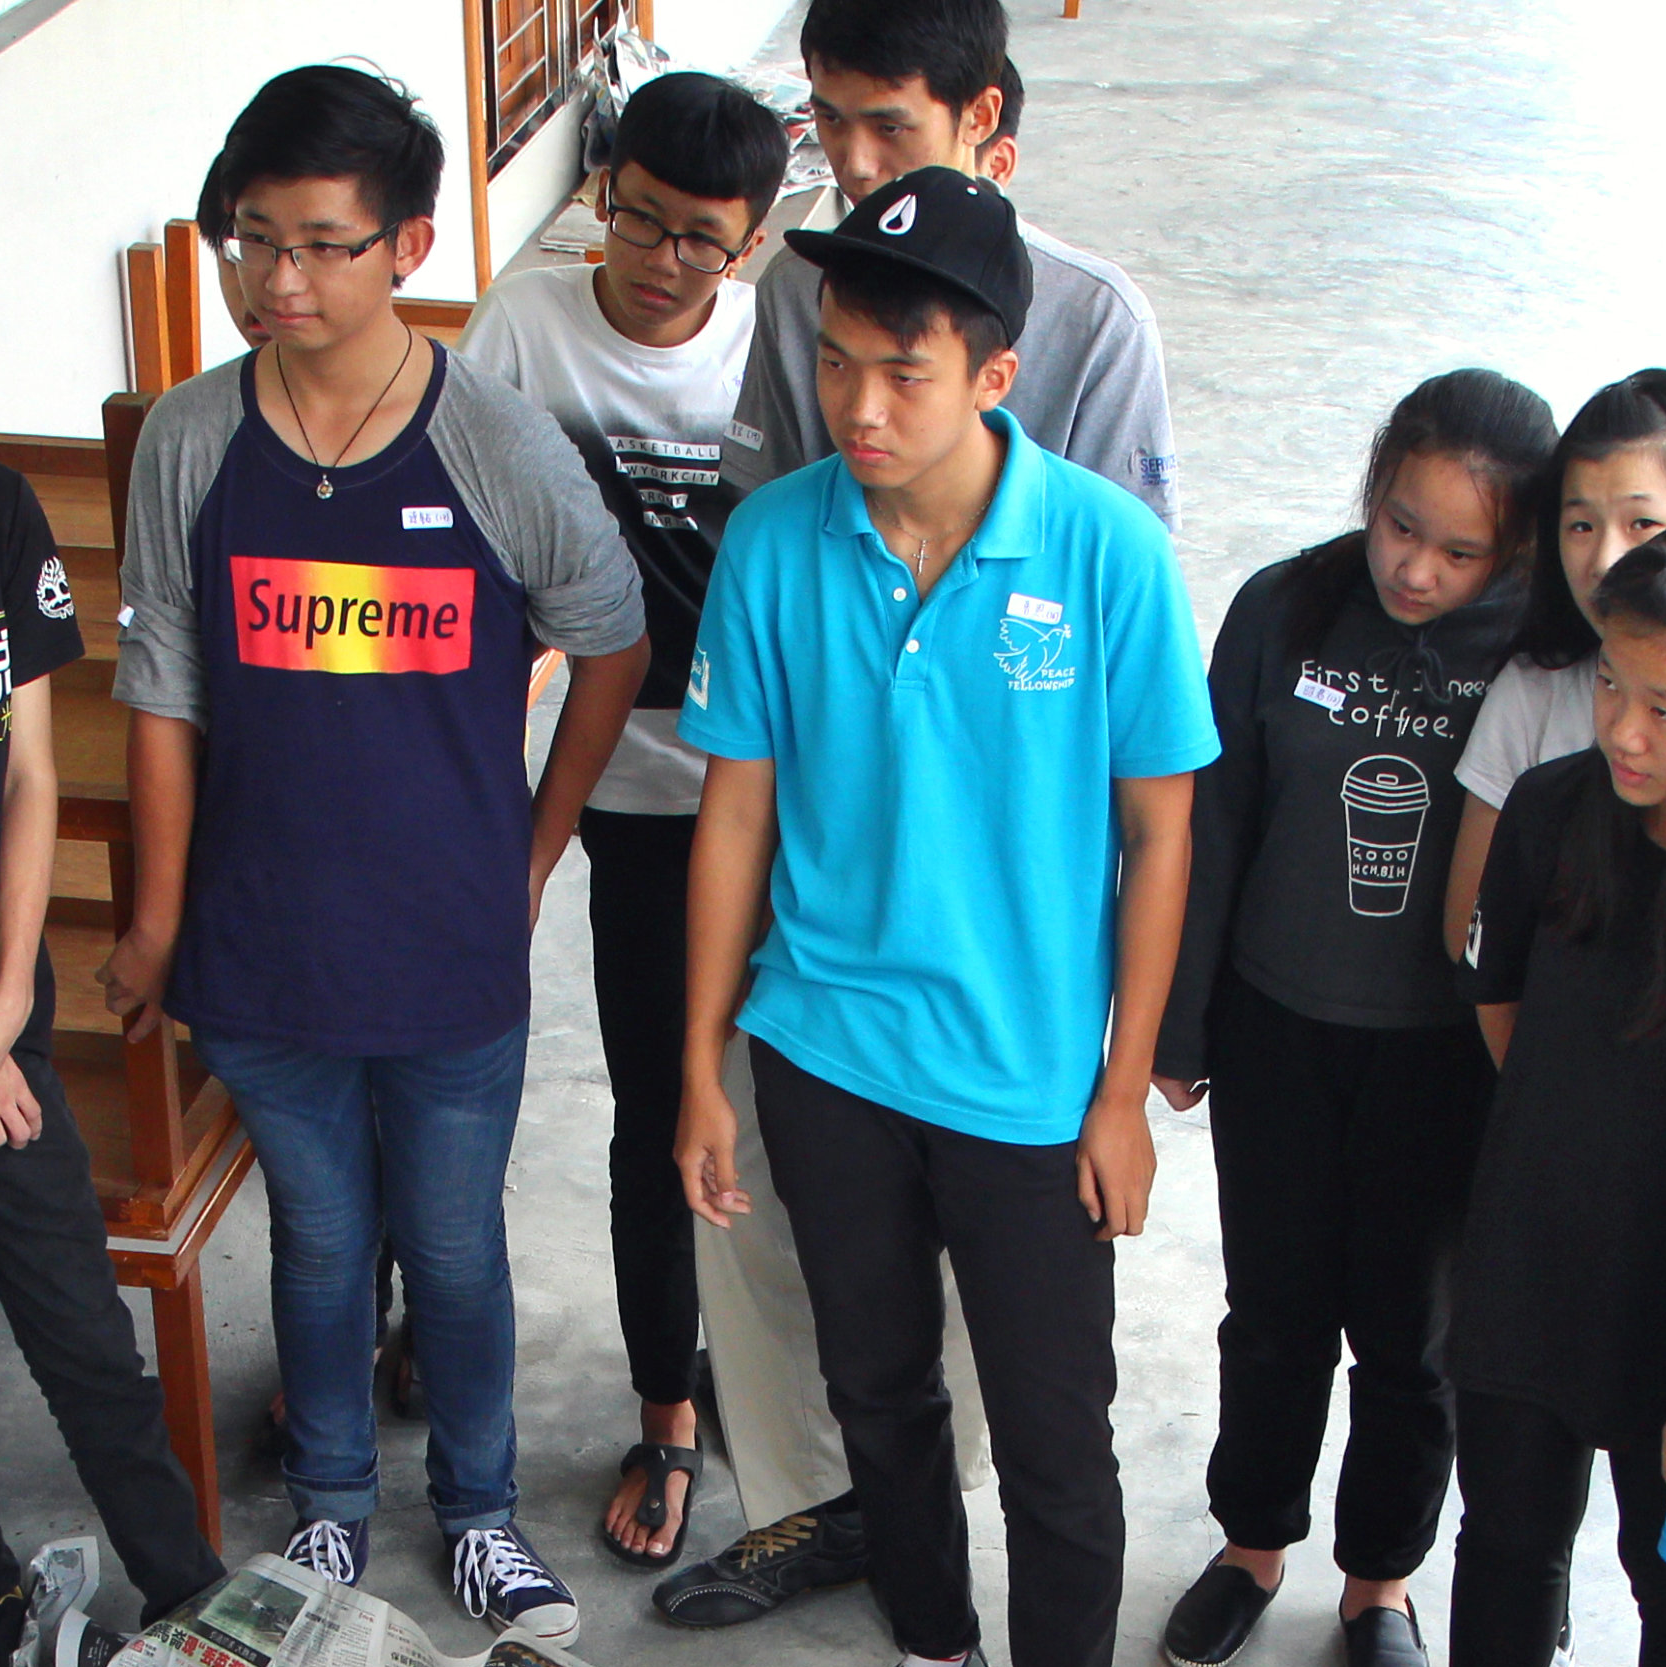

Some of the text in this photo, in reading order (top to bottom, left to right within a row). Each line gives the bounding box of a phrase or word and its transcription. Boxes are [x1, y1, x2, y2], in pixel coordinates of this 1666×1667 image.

[248, 578, 459, 650] Supreme
[1041, 667, 1075, 679] PEACE
[1008, 678, 1075, 691] FELLOWSHIP
[1448, 679, 1492, 698] nee
